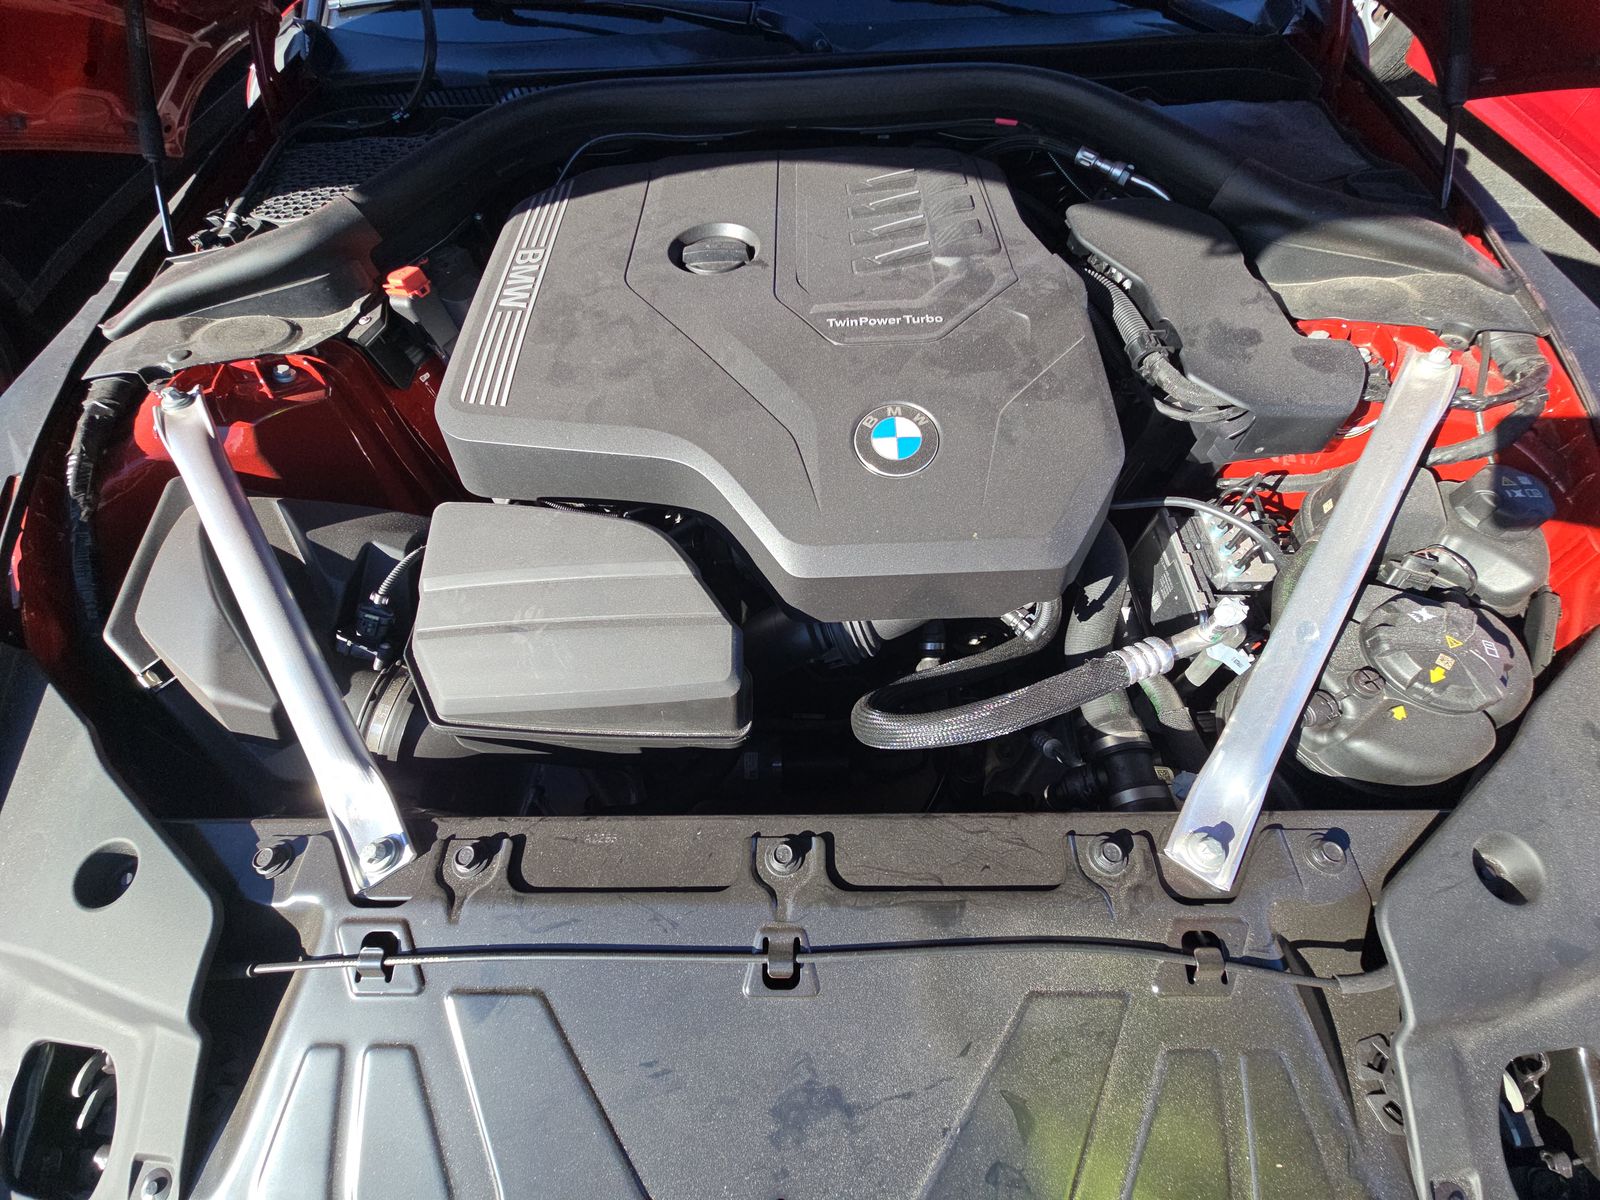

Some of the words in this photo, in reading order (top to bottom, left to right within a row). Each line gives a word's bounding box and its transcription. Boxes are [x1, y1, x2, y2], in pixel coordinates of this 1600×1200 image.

[499, 248, 546, 308] BMW
[826, 316, 901, 327] TwinPower
[902, 314, 943, 324] Turbo
[862, 406, 928, 429] BMW
